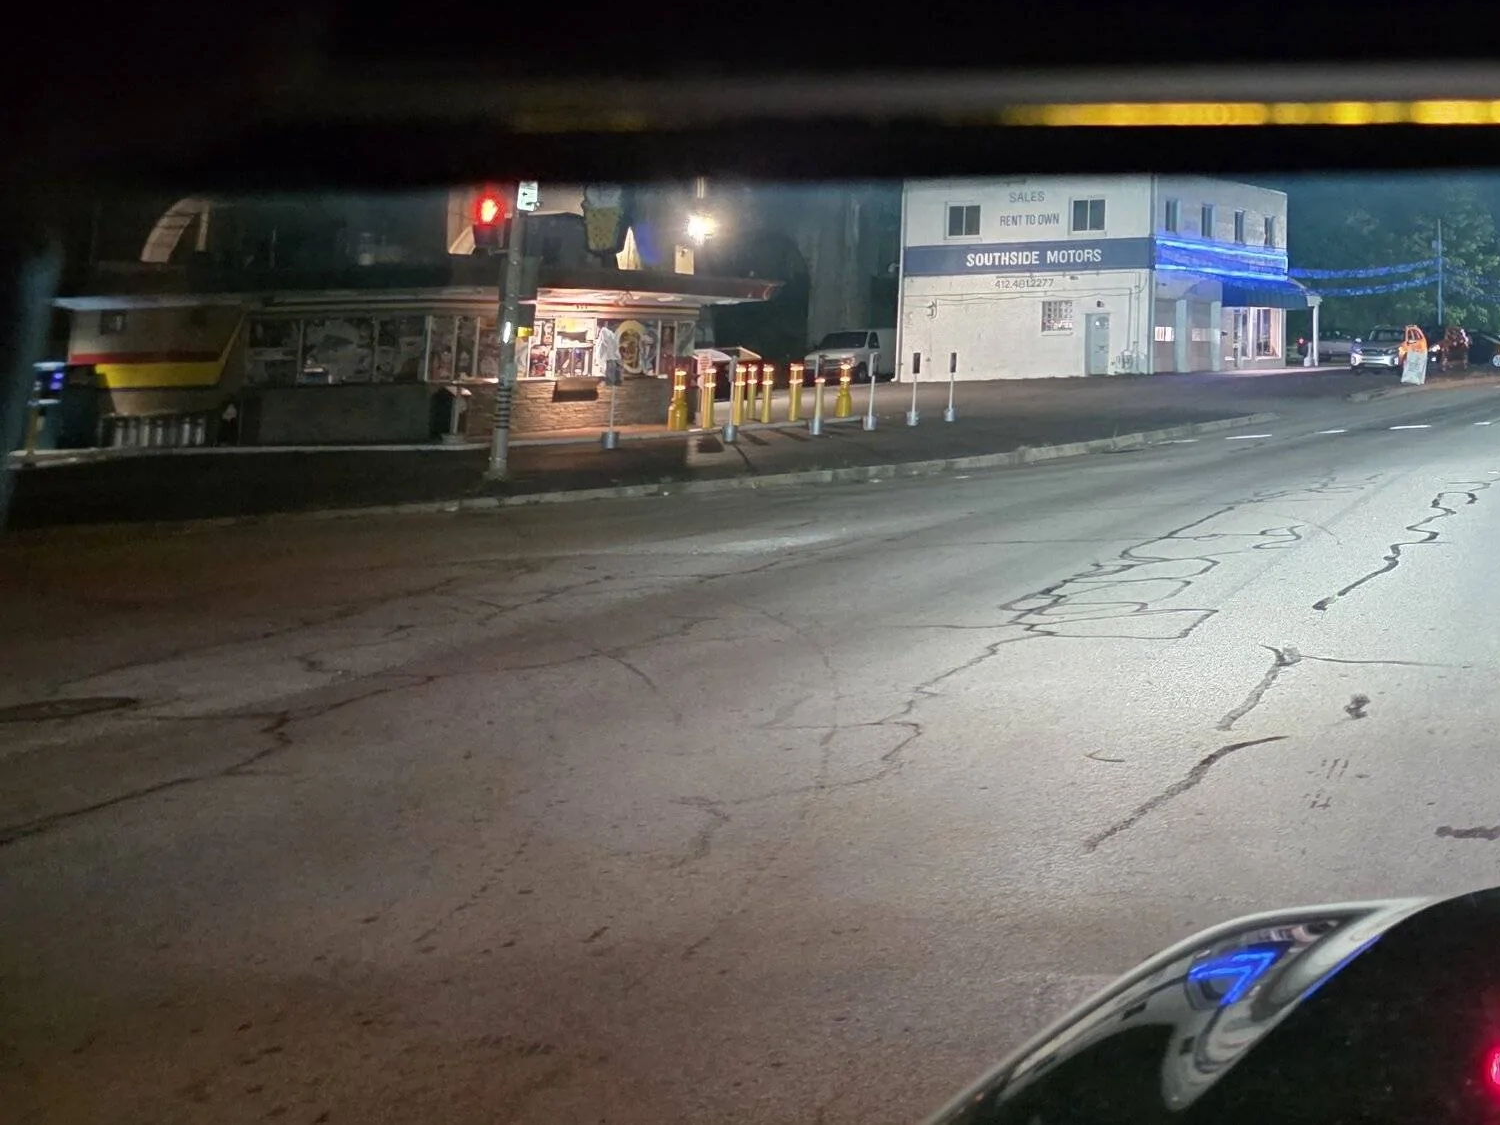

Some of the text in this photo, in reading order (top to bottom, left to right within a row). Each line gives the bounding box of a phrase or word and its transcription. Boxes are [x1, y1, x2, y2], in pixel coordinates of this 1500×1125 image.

[1009, 191, 1045, 203] SALES
[1000, 213, 1060, 226] RENT TO OWN
[966, 249, 1102, 267] SOUTHSIDE MOTORS
